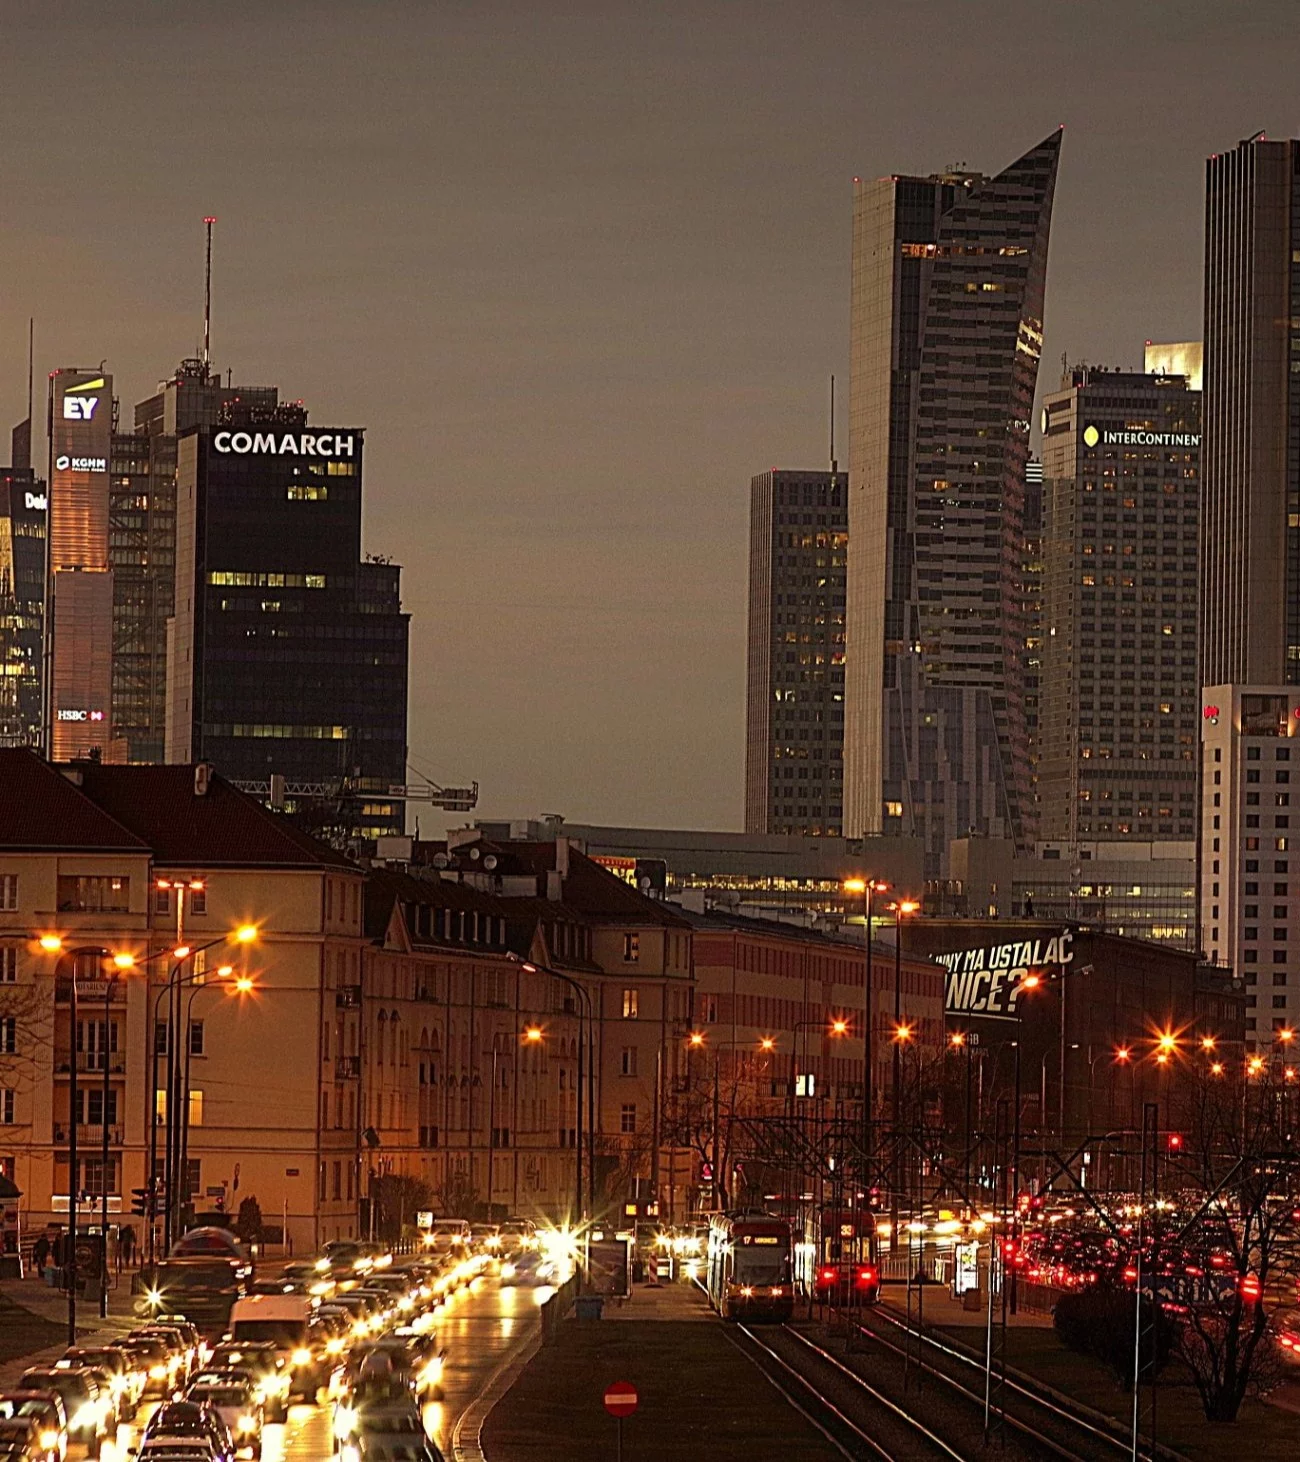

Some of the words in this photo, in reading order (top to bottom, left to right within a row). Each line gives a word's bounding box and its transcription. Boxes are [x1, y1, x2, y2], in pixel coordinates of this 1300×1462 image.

[63, 396, 98, 420] EY
[214, 431, 354, 457] COMARCH
[71, 458, 106, 468] KGHM
[57, 709, 87, 721] HSBC
[963, 949, 985, 971] MA
[988, 928, 1074, 969] USTALAĆ
[944, 968, 1029, 1012] NICE?
